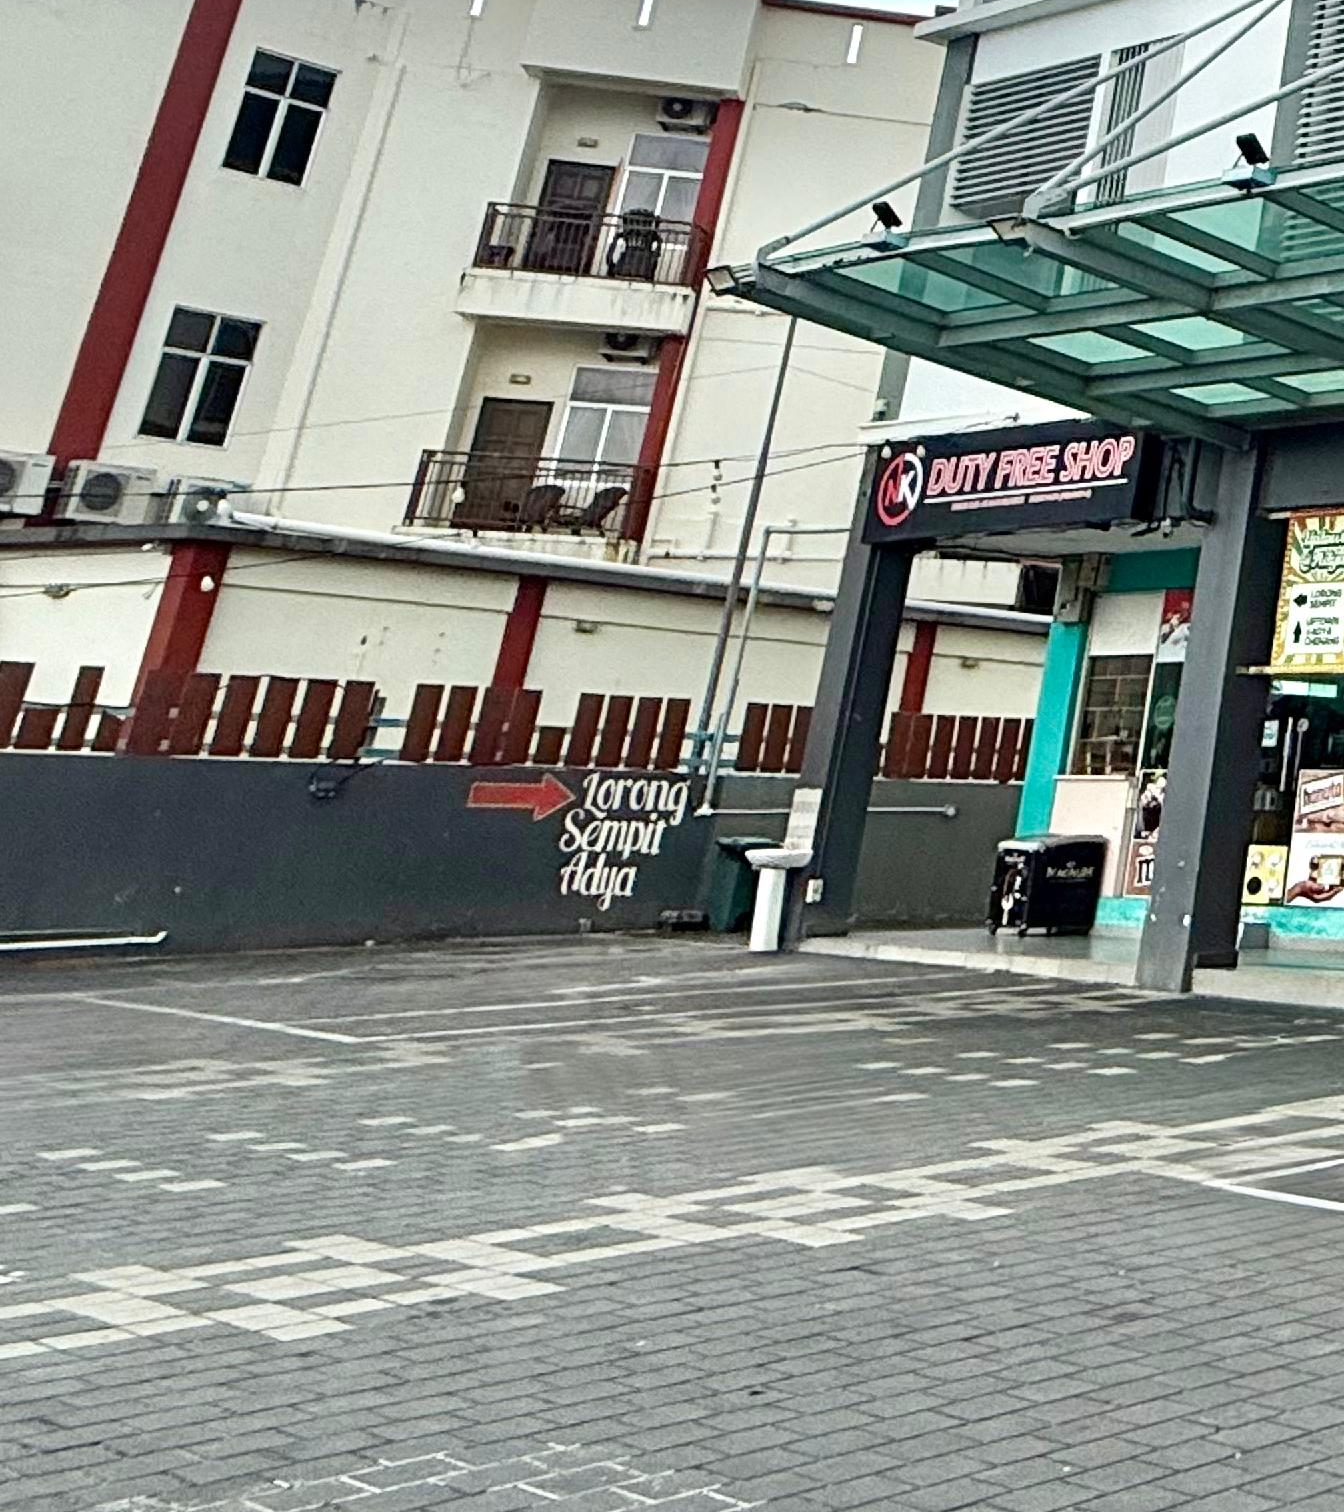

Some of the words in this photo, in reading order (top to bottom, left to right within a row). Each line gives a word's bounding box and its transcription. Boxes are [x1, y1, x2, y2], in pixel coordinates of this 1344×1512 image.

[926, 452, 995, 496] DUTY
[994, 444, 1060, 488] FREE
[1060, 436, 1136, 479] SHOP
[583, 772, 690, 825] Lorong
[559, 809, 668, 859] Sempit
[560, 852, 637, 911] Adya
